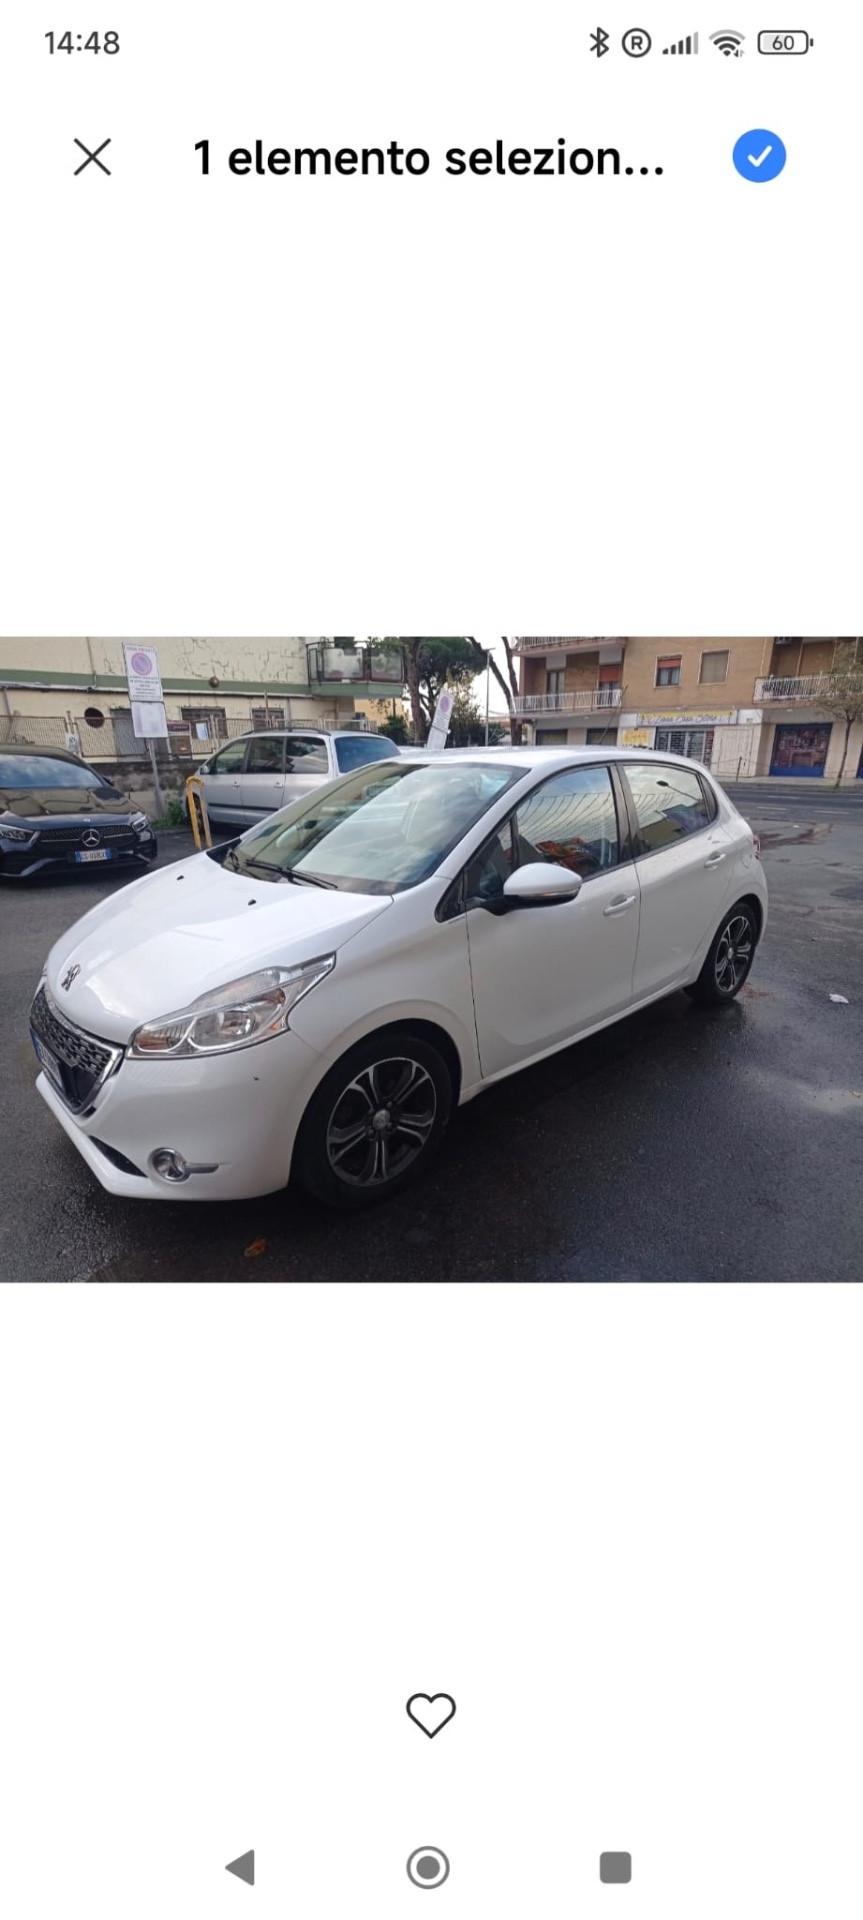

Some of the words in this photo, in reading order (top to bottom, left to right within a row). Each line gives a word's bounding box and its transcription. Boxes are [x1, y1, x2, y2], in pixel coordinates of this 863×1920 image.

[44, 31, 120, 55] 14:48
[772, 35, 795, 51] 60
[194, 139, 209, 175] 1
[228, 139, 430, 176] elemento
[445, 137, 664, 176] selezion...
